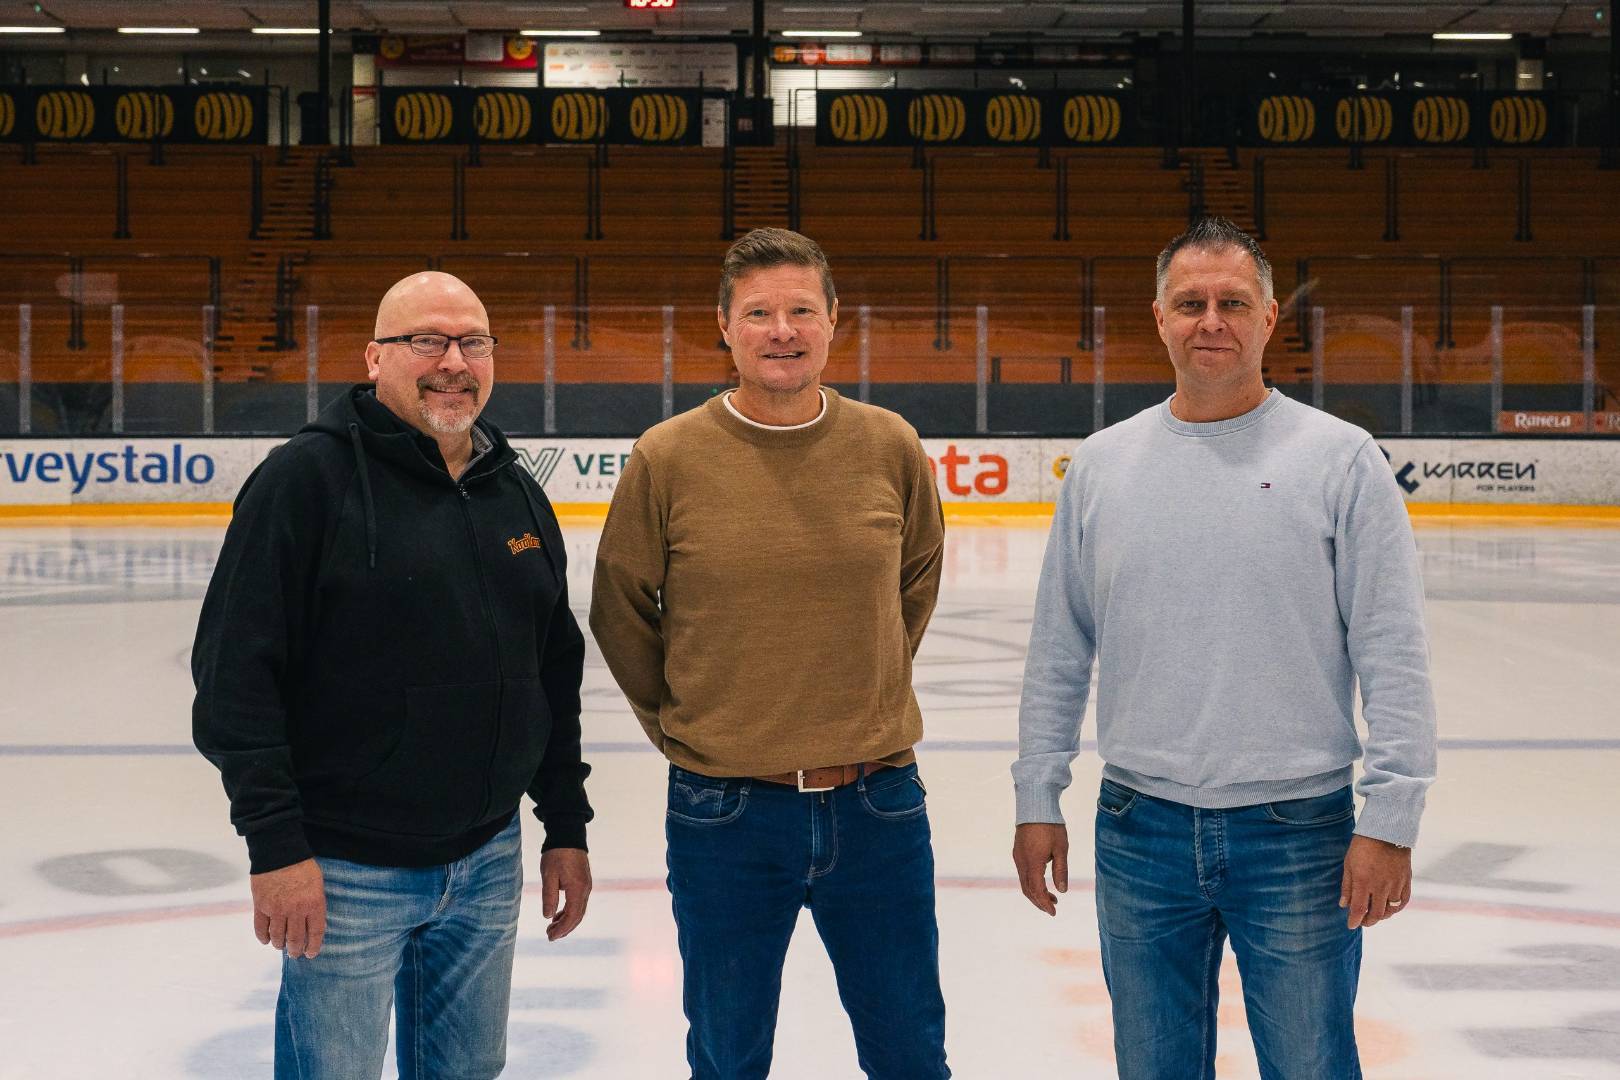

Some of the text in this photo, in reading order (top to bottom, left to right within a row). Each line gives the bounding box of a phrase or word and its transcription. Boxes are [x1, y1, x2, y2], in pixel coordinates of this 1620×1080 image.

[36, 92, 95, 138] OLVI
[195, 93, 253, 139] OLVI
[395, 93, 453, 139] OLVI
[629, 94, 688, 140] OLVI
[830, 94, 888, 141] OLVI
[986, 95, 1041, 141] OLVI
[1063, 95, 1121, 141] OLVI
[1258, 96, 1316, 141] OLVI
[1413, 97, 1470, 141] OLVI
[1490, 97, 1547, 141] OLVI
[0, 444, 215, 494] veystalo
[927, 444, 1009, 496] ta
